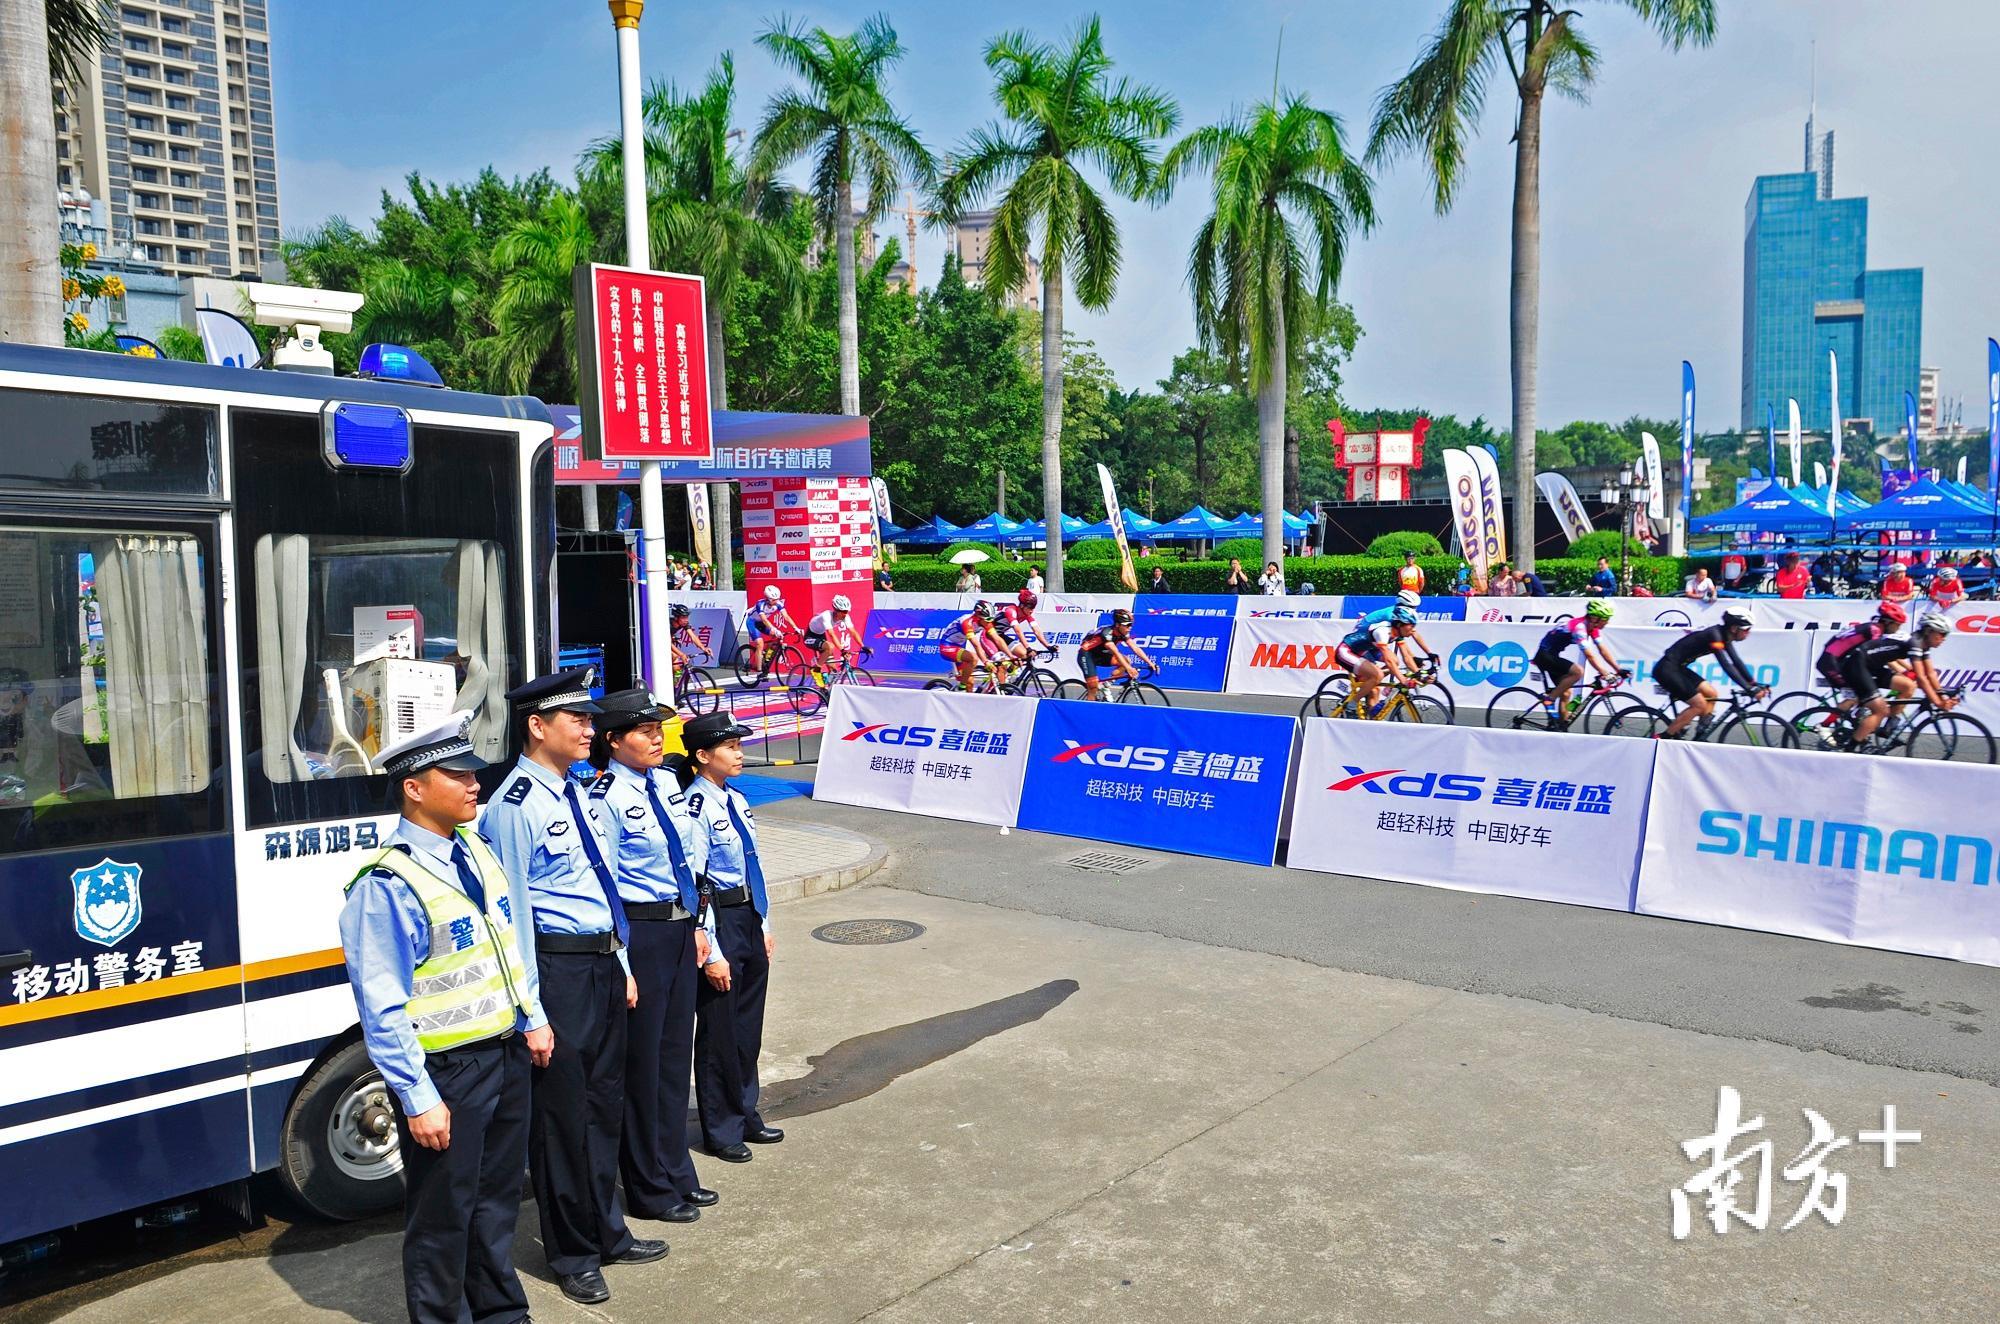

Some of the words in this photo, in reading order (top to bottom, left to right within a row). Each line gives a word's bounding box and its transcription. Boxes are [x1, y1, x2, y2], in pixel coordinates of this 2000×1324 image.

[631, 287, 645, 353] 伟大旗帜
[609, 285, 627, 413] 实党的十九大精神
[653, 290, 672, 444] 中国特色社会主义思想
[675, 323, 692, 446] 高举习近平新时代
[781, 530, 804, 539] neco
[1458, 474, 1479, 561] neco
[750, 566, 773, 574] KENDA
[1161, 656, 1194, 667] 中国好车
[1171, 636, 1219, 651] 喜德盛
[1454, 654, 1524, 674] KMC
[938, 728, 1012, 757] 喜德盛
[869, 754, 916, 776] 超轻科技
[922, 761, 973, 781] 中国好车
[1171, 749, 1265, 784] 喜德盛
[1086, 778, 1144, 803] 超轻科技
[1152, 785, 1216, 811] 中国好车
[1491, 778, 1616, 815] 喜德盛
[265, 821, 379, 861] 森源鸿马
[1376, 810, 1455, 838] 超轻科技
[1467, 820, 1552, 849] 中国好车
[1696, 810, 2000, 886] SHIMAN
[12, 940, 205, 1004] 移动警务室
